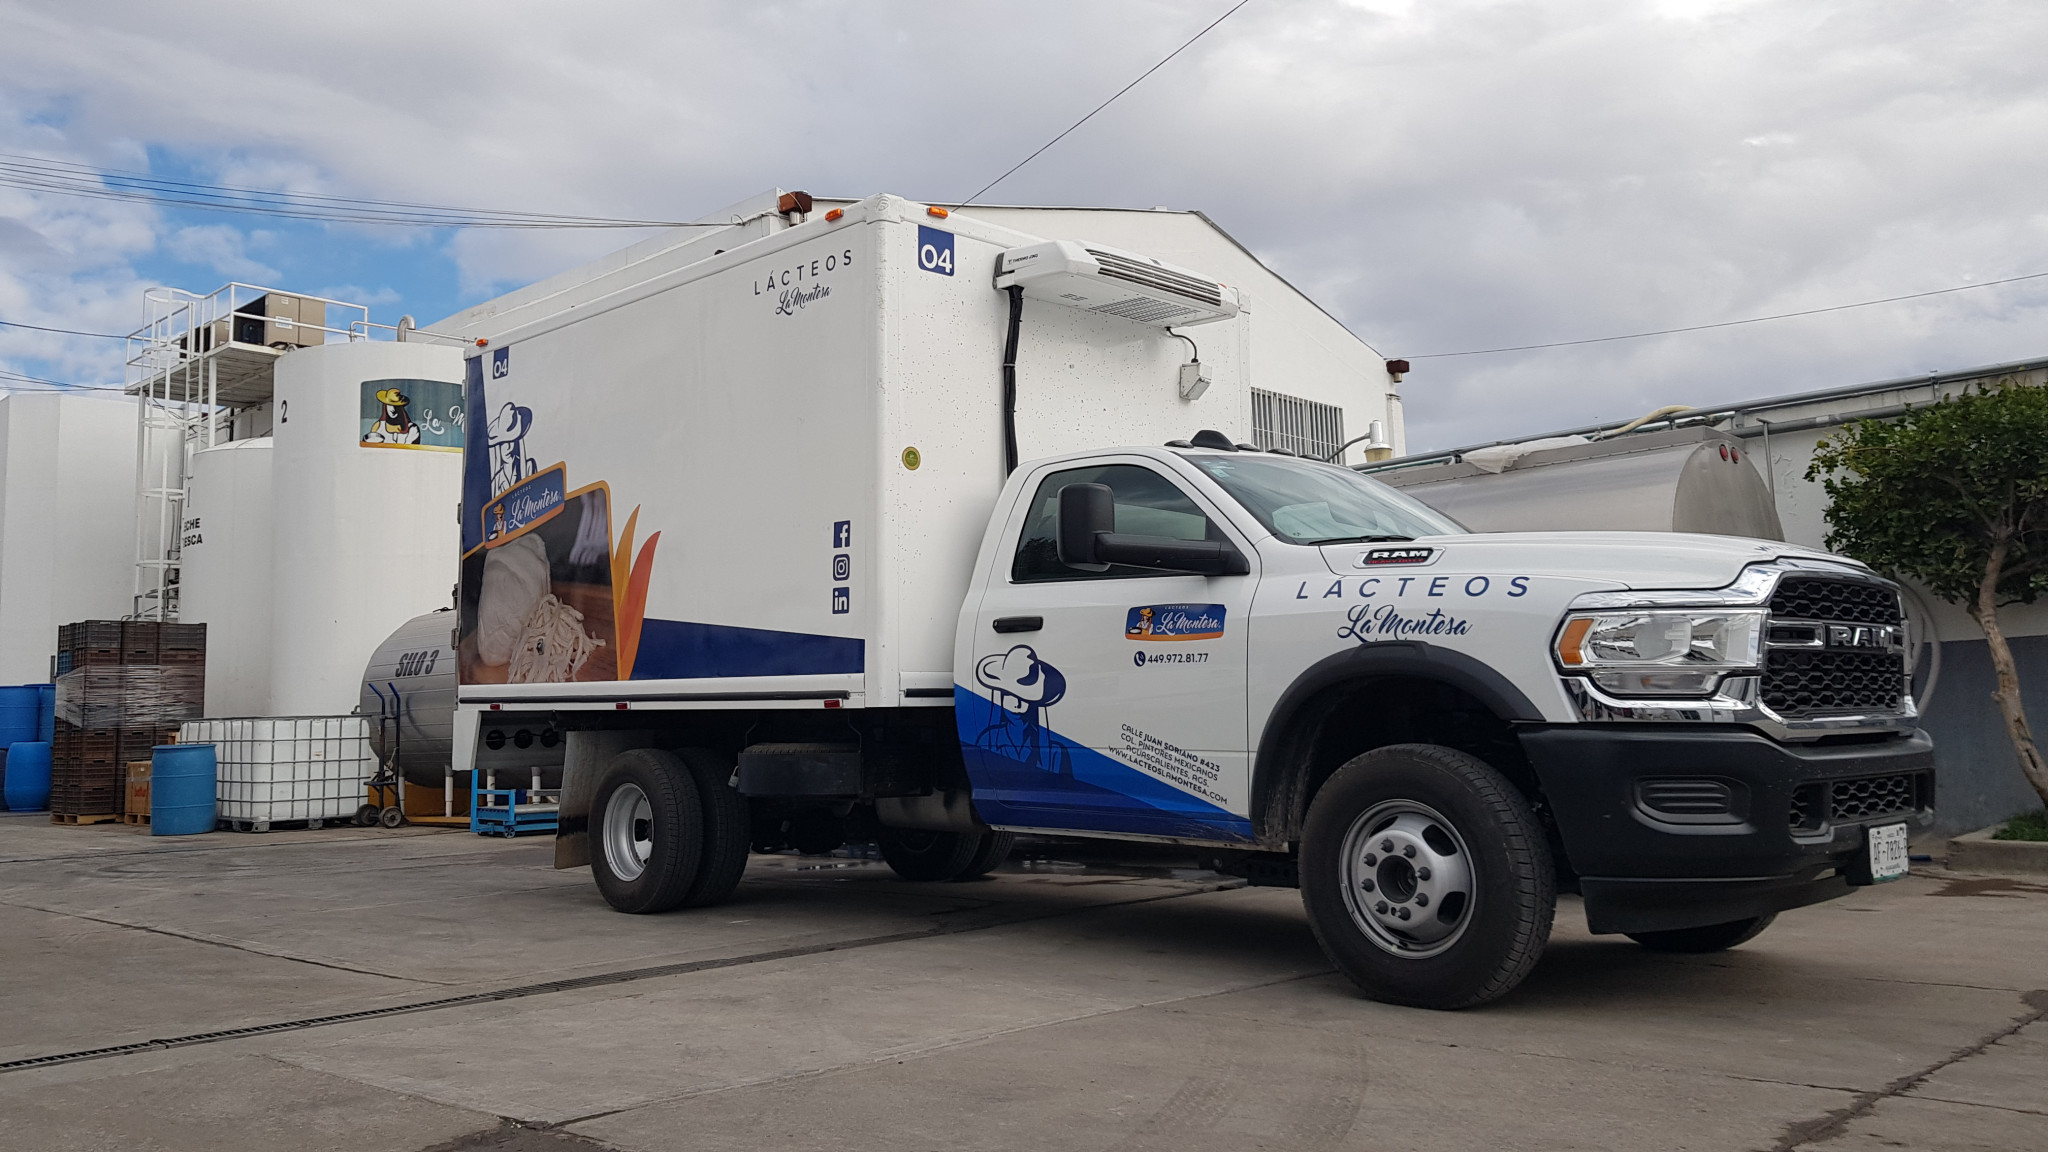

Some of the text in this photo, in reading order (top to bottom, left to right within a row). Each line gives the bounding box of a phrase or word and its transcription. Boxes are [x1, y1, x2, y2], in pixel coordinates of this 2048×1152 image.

[754, 249, 852, 296] LÁCTEOS
[921, 244, 953, 273] 04
[775, 282, 832, 316] La Montesa
[493, 359, 507, 378] 04
[280, 399, 288, 424] 2
[421, 408, 445, 435] La
[508, 487, 561, 529] La Montesa
[1372, 550, 1429, 559] RAM
[1156, 611, 1219, 636] La Montesa
[1337, 603, 1473, 643] La Montesa
[1830, 626, 1892, 648] RAM
[395, 649, 440, 677] SILO 3
[1147, 652, 1209, 664] 449.972.81.77
[1120, 732, 1219, 782] COL. PINTORES MEXICANOS
[1121, 723, 1221, 773] CALLE JUAN SORIANO #423
[1108, 745, 1228, 805] WWW.LACTEOSLAMONTESA.COM
[1126, 744, 1210, 788] AGUASCALIENTES, AGS.
